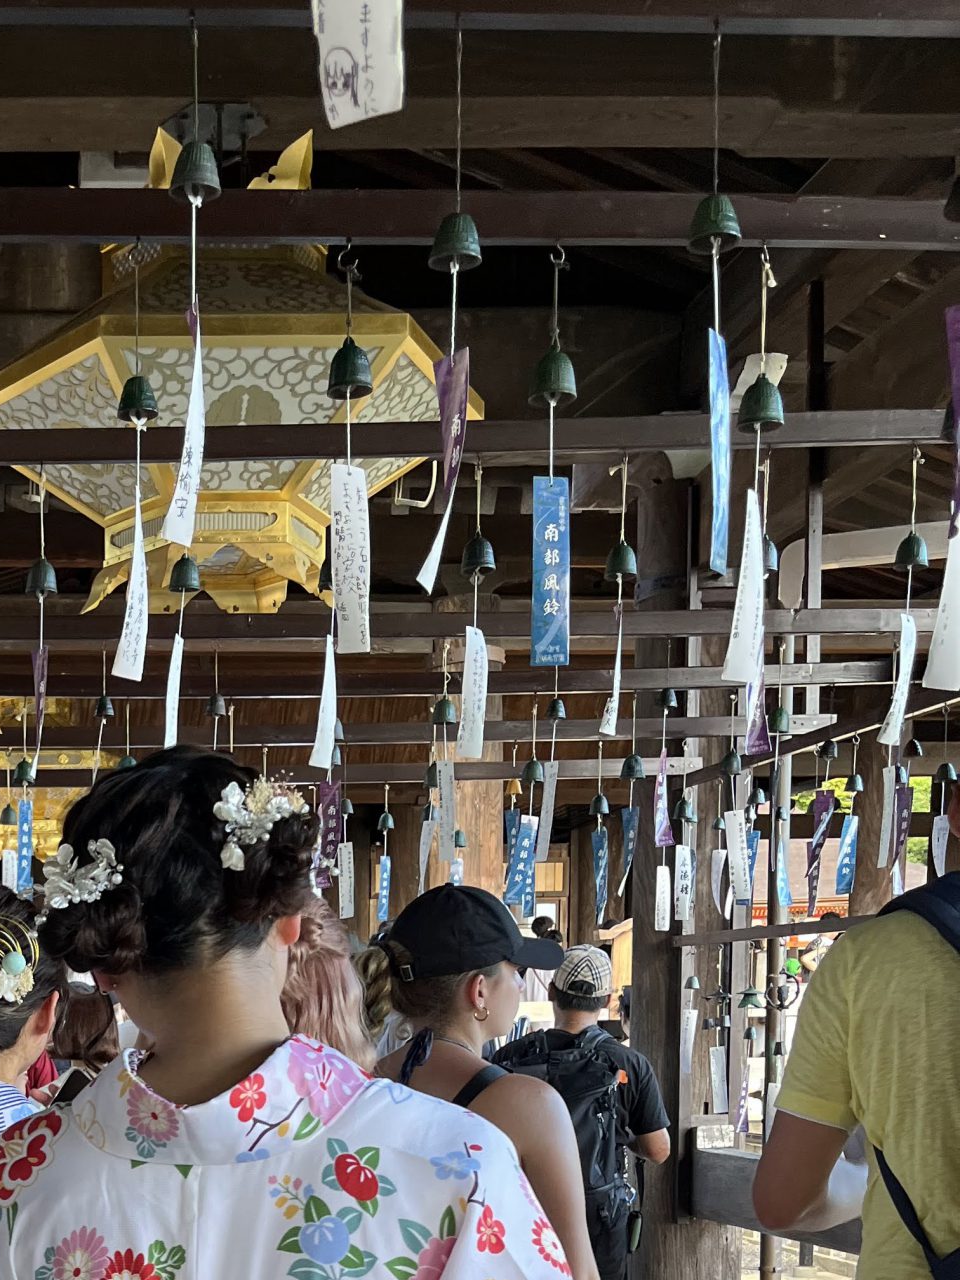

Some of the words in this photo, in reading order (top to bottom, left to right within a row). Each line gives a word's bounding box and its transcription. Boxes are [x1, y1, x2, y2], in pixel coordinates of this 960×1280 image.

[544, 523, 560, 616] 南部風鈴
[326, 805, 336, 853] 南部風鈴
[514, 838, 530, 882] 南部風鈴
[841, 835, 852, 875] 南部風鈴
